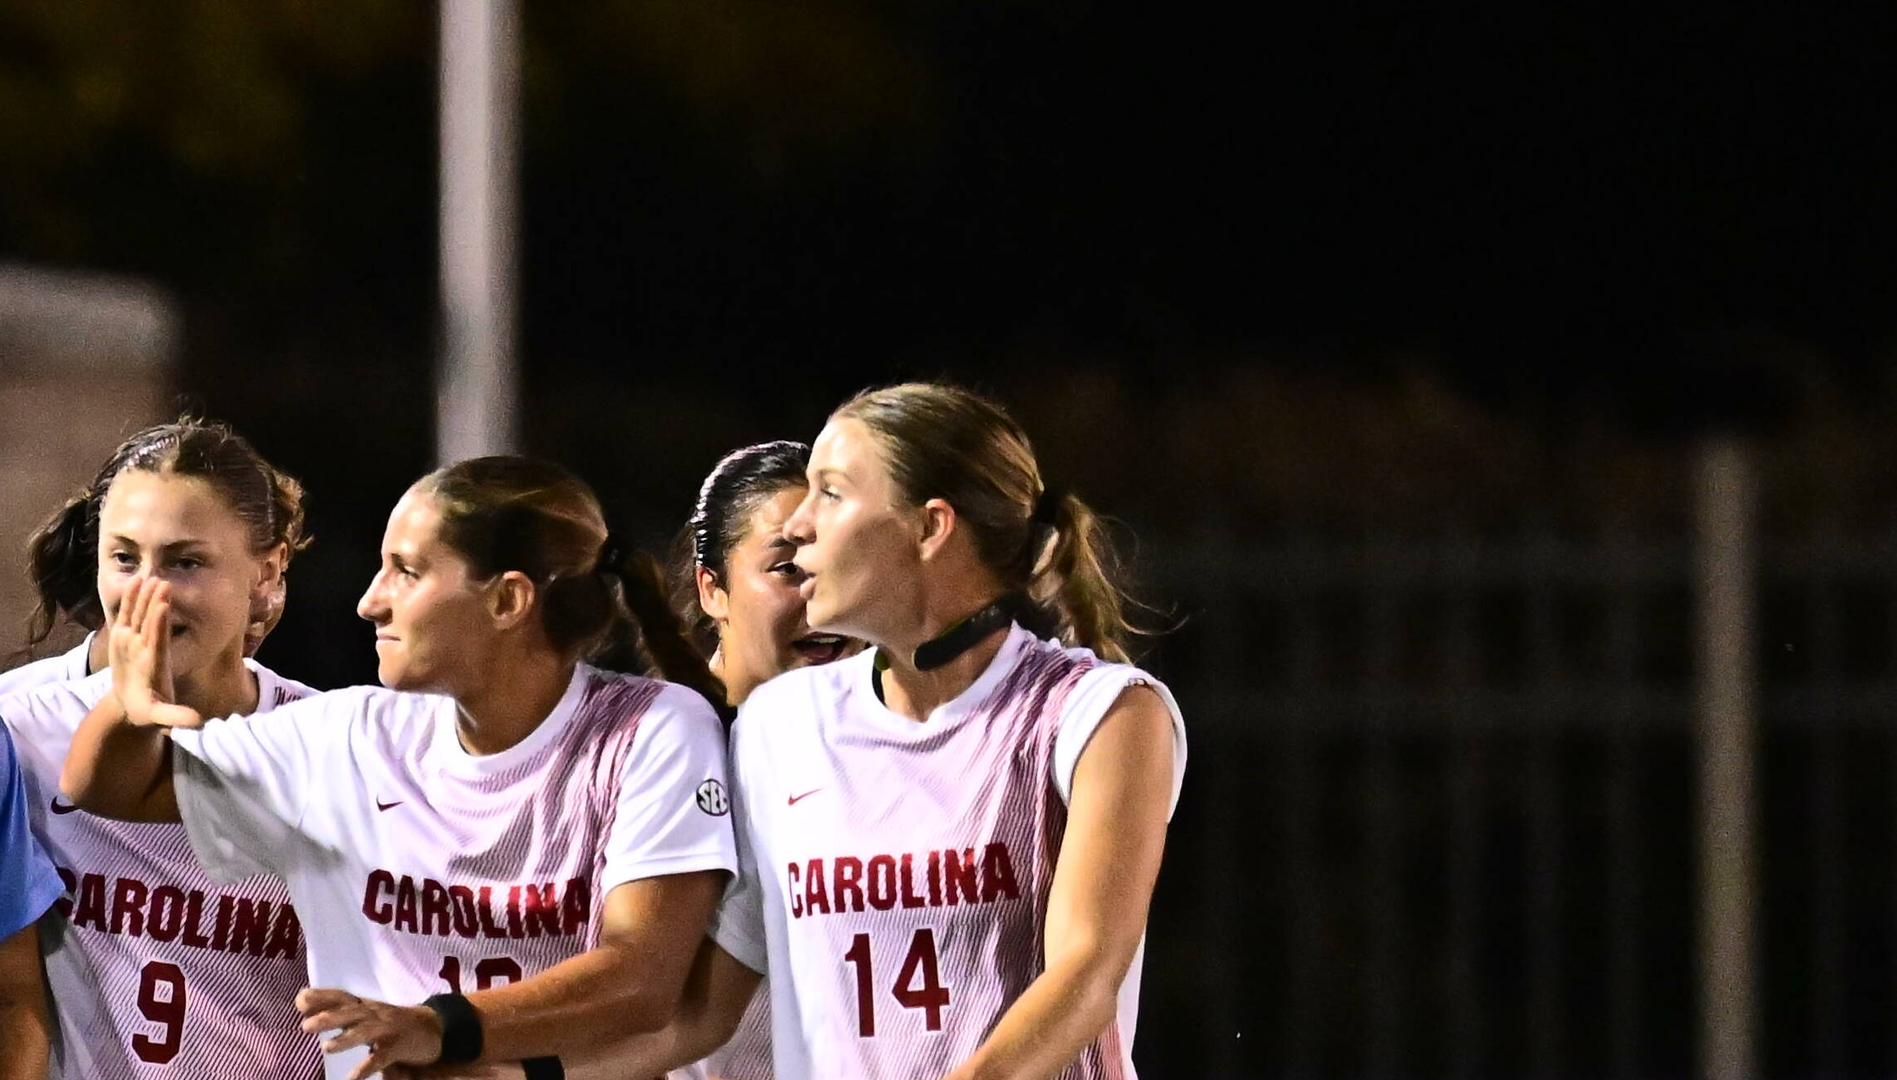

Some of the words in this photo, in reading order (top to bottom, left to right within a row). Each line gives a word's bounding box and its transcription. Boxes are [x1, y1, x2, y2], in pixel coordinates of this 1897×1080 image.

[362, 869, 591, 939] CAROLINA
[788, 842, 1021, 918] CAROLINA
[132, 961, 187, 1064] 9
[845, 929, 950, 1037] 14
